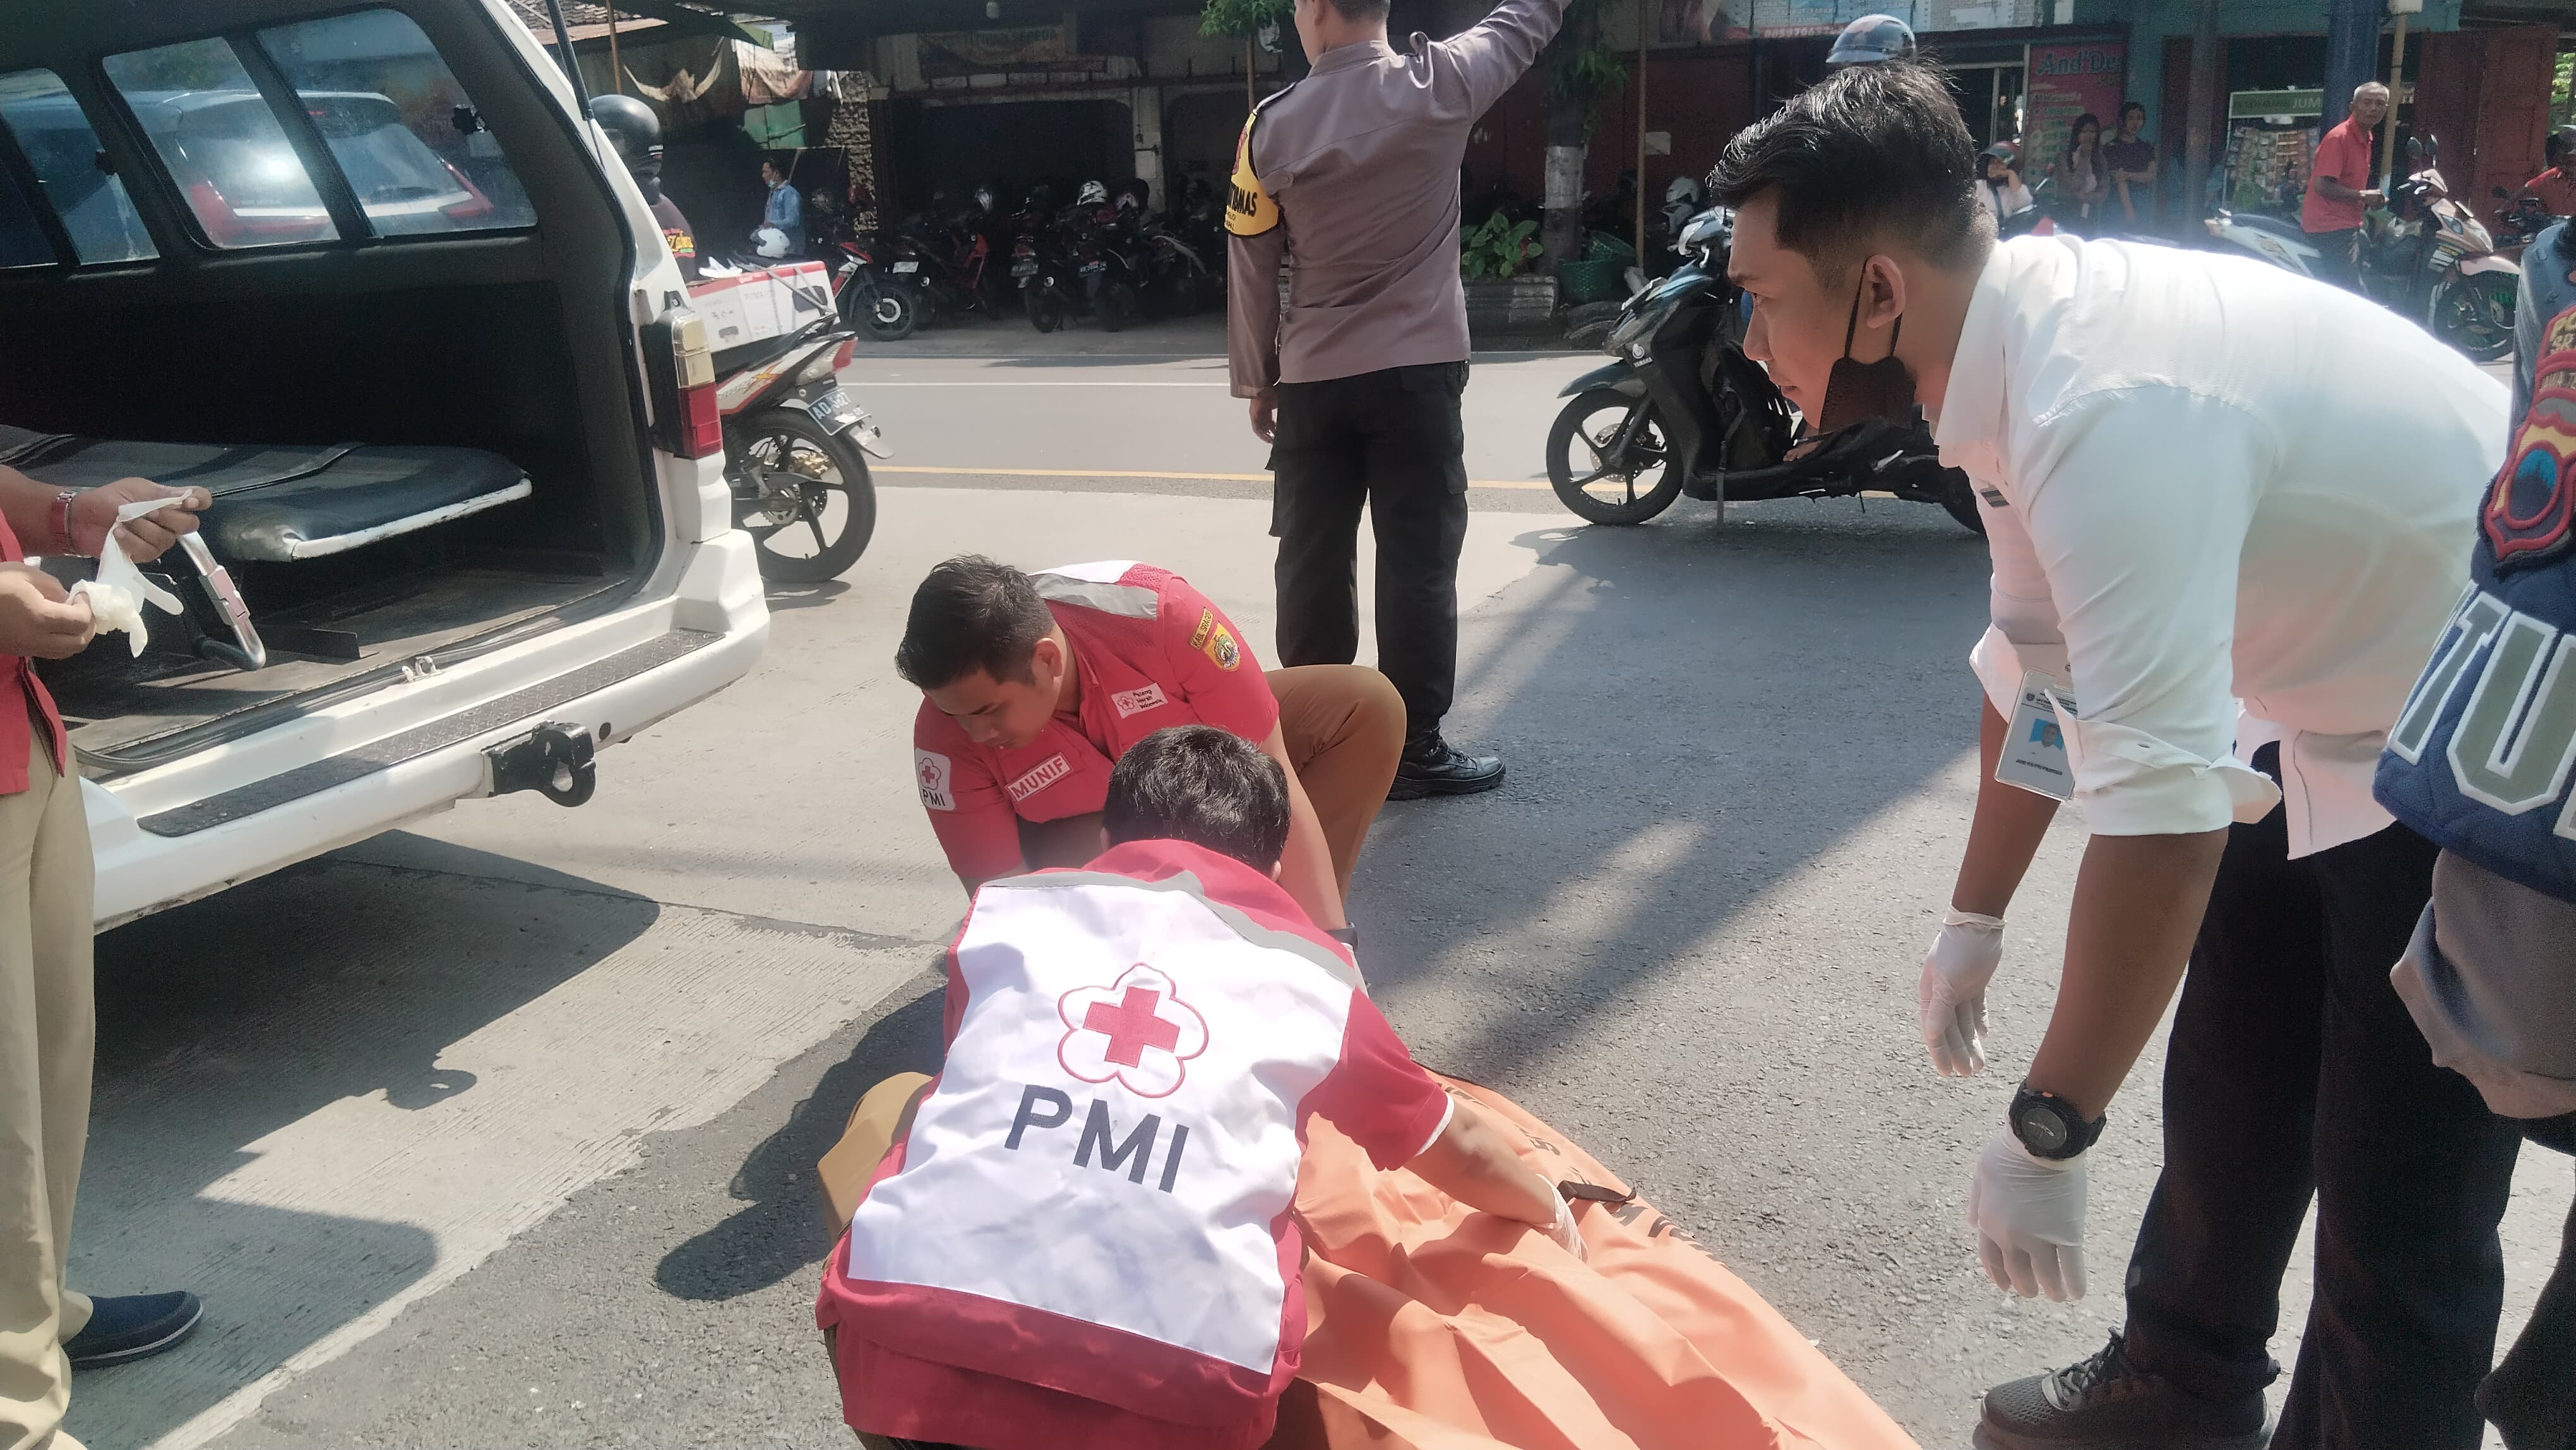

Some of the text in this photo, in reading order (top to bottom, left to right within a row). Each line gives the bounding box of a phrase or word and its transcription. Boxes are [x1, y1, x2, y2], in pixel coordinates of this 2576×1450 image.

[1633, 357, 1653, 368] YAMAHA
[812, 402, 832, 420] AD
[1010, 757, 1064, 799] MUNIF
[922, 789, 946, 807] PMI
[1004, 1084, 1190, 1194] PMI
